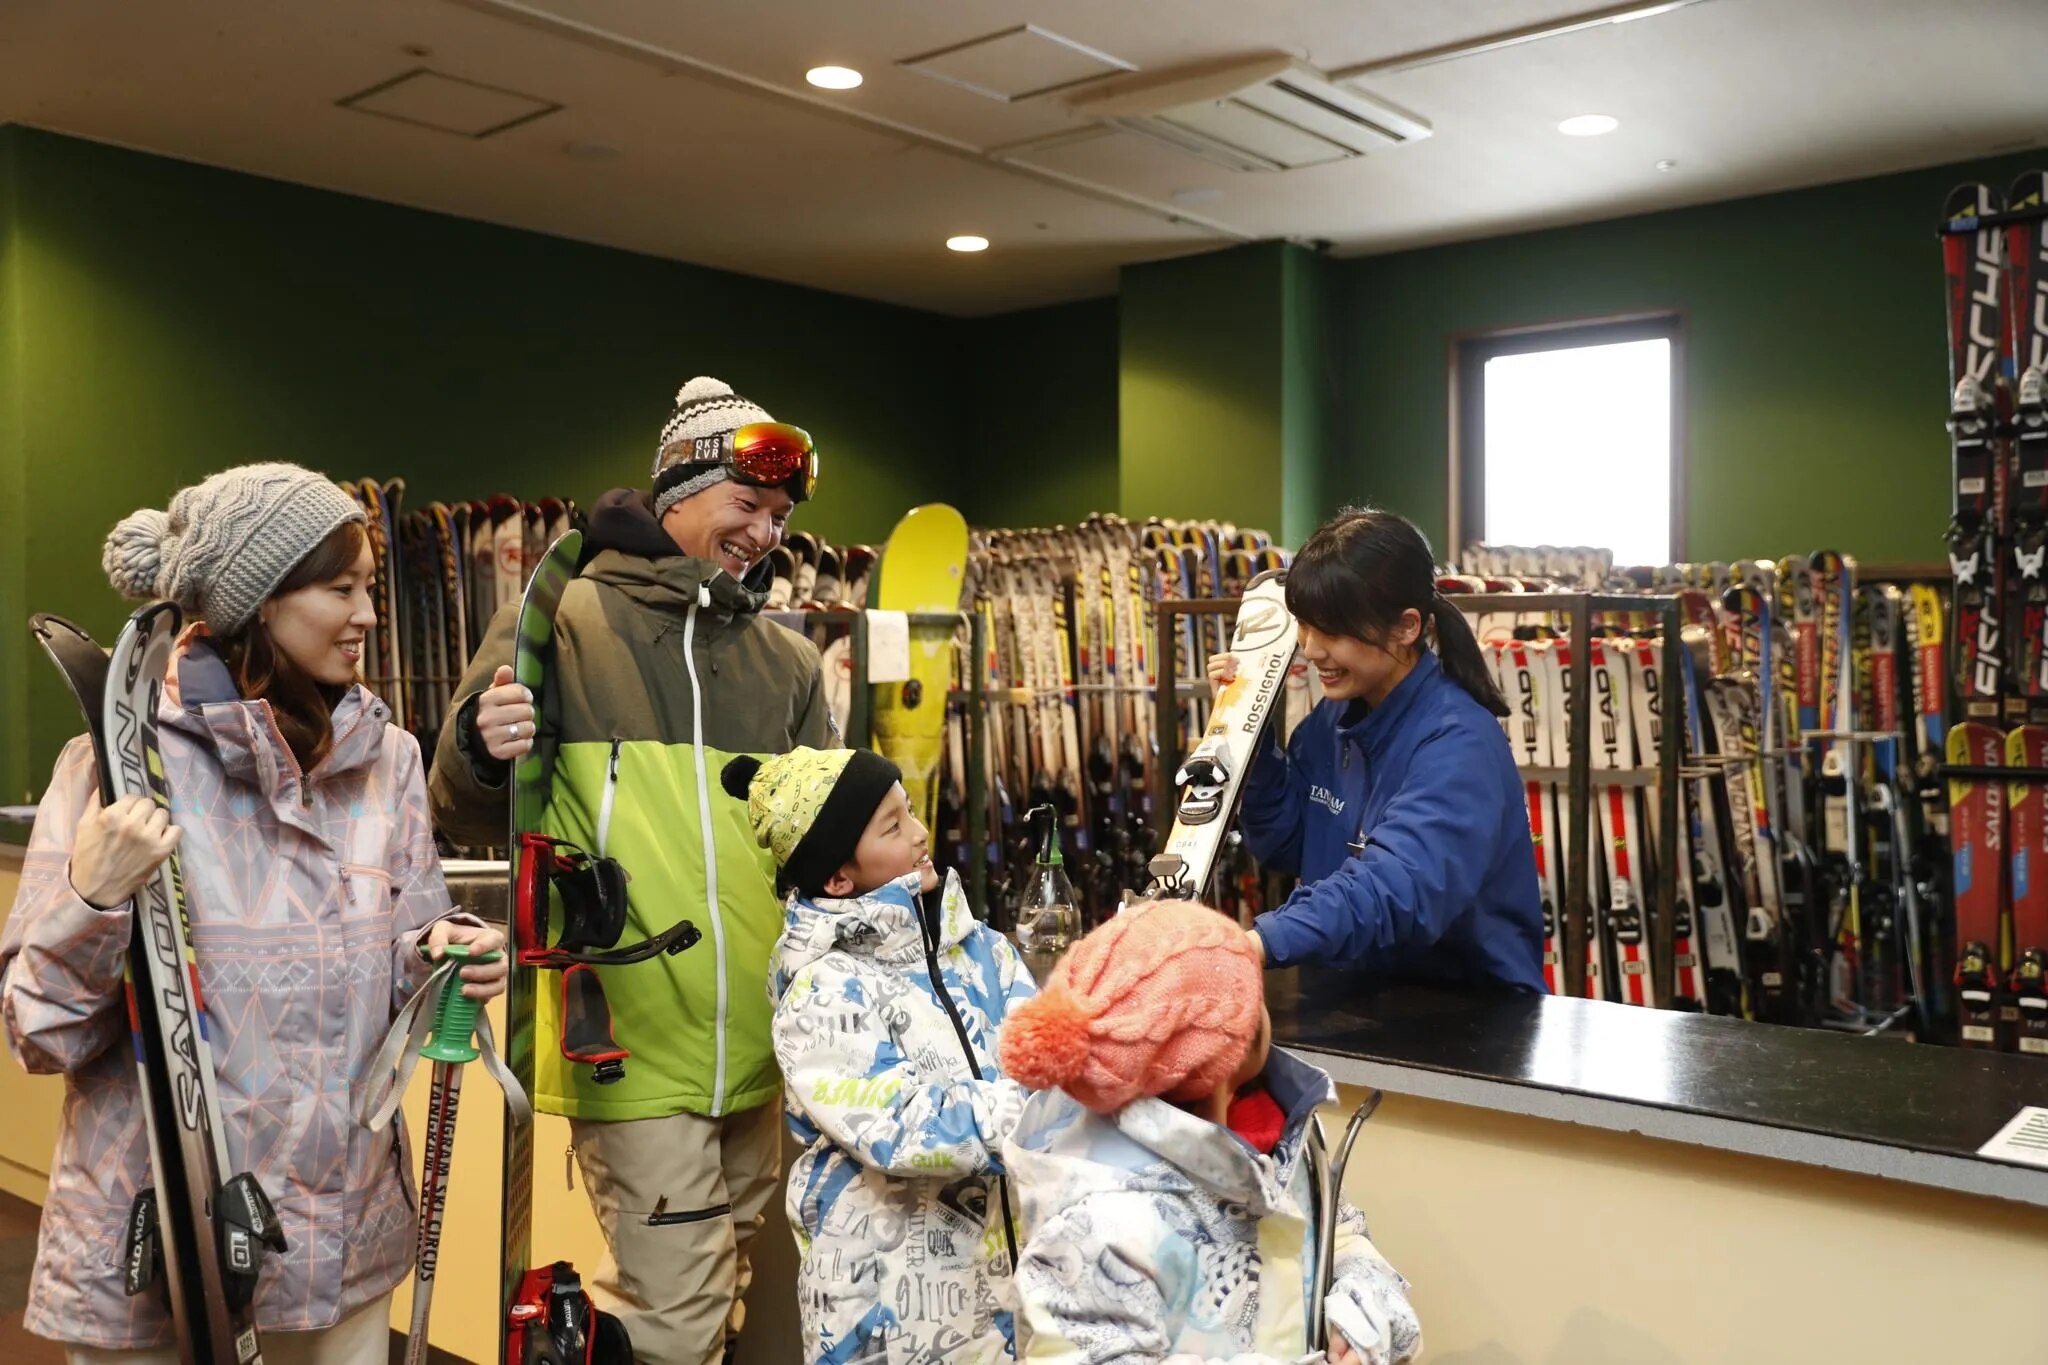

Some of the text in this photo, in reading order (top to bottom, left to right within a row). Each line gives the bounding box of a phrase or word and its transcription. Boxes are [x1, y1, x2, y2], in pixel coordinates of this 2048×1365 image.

[695, 449, 718, 459] LVR
[1518, 669, 1538, 766] HEAD
[1595, 668, 1619, 768] HEAD
[1983, 737, 2000, 851] SALOON
[438, 1086, 460, 1177] TANGRAM
[434, 1184, 448, 1207] SKI
[420, 1220, 442, 1282] CIRCUS
